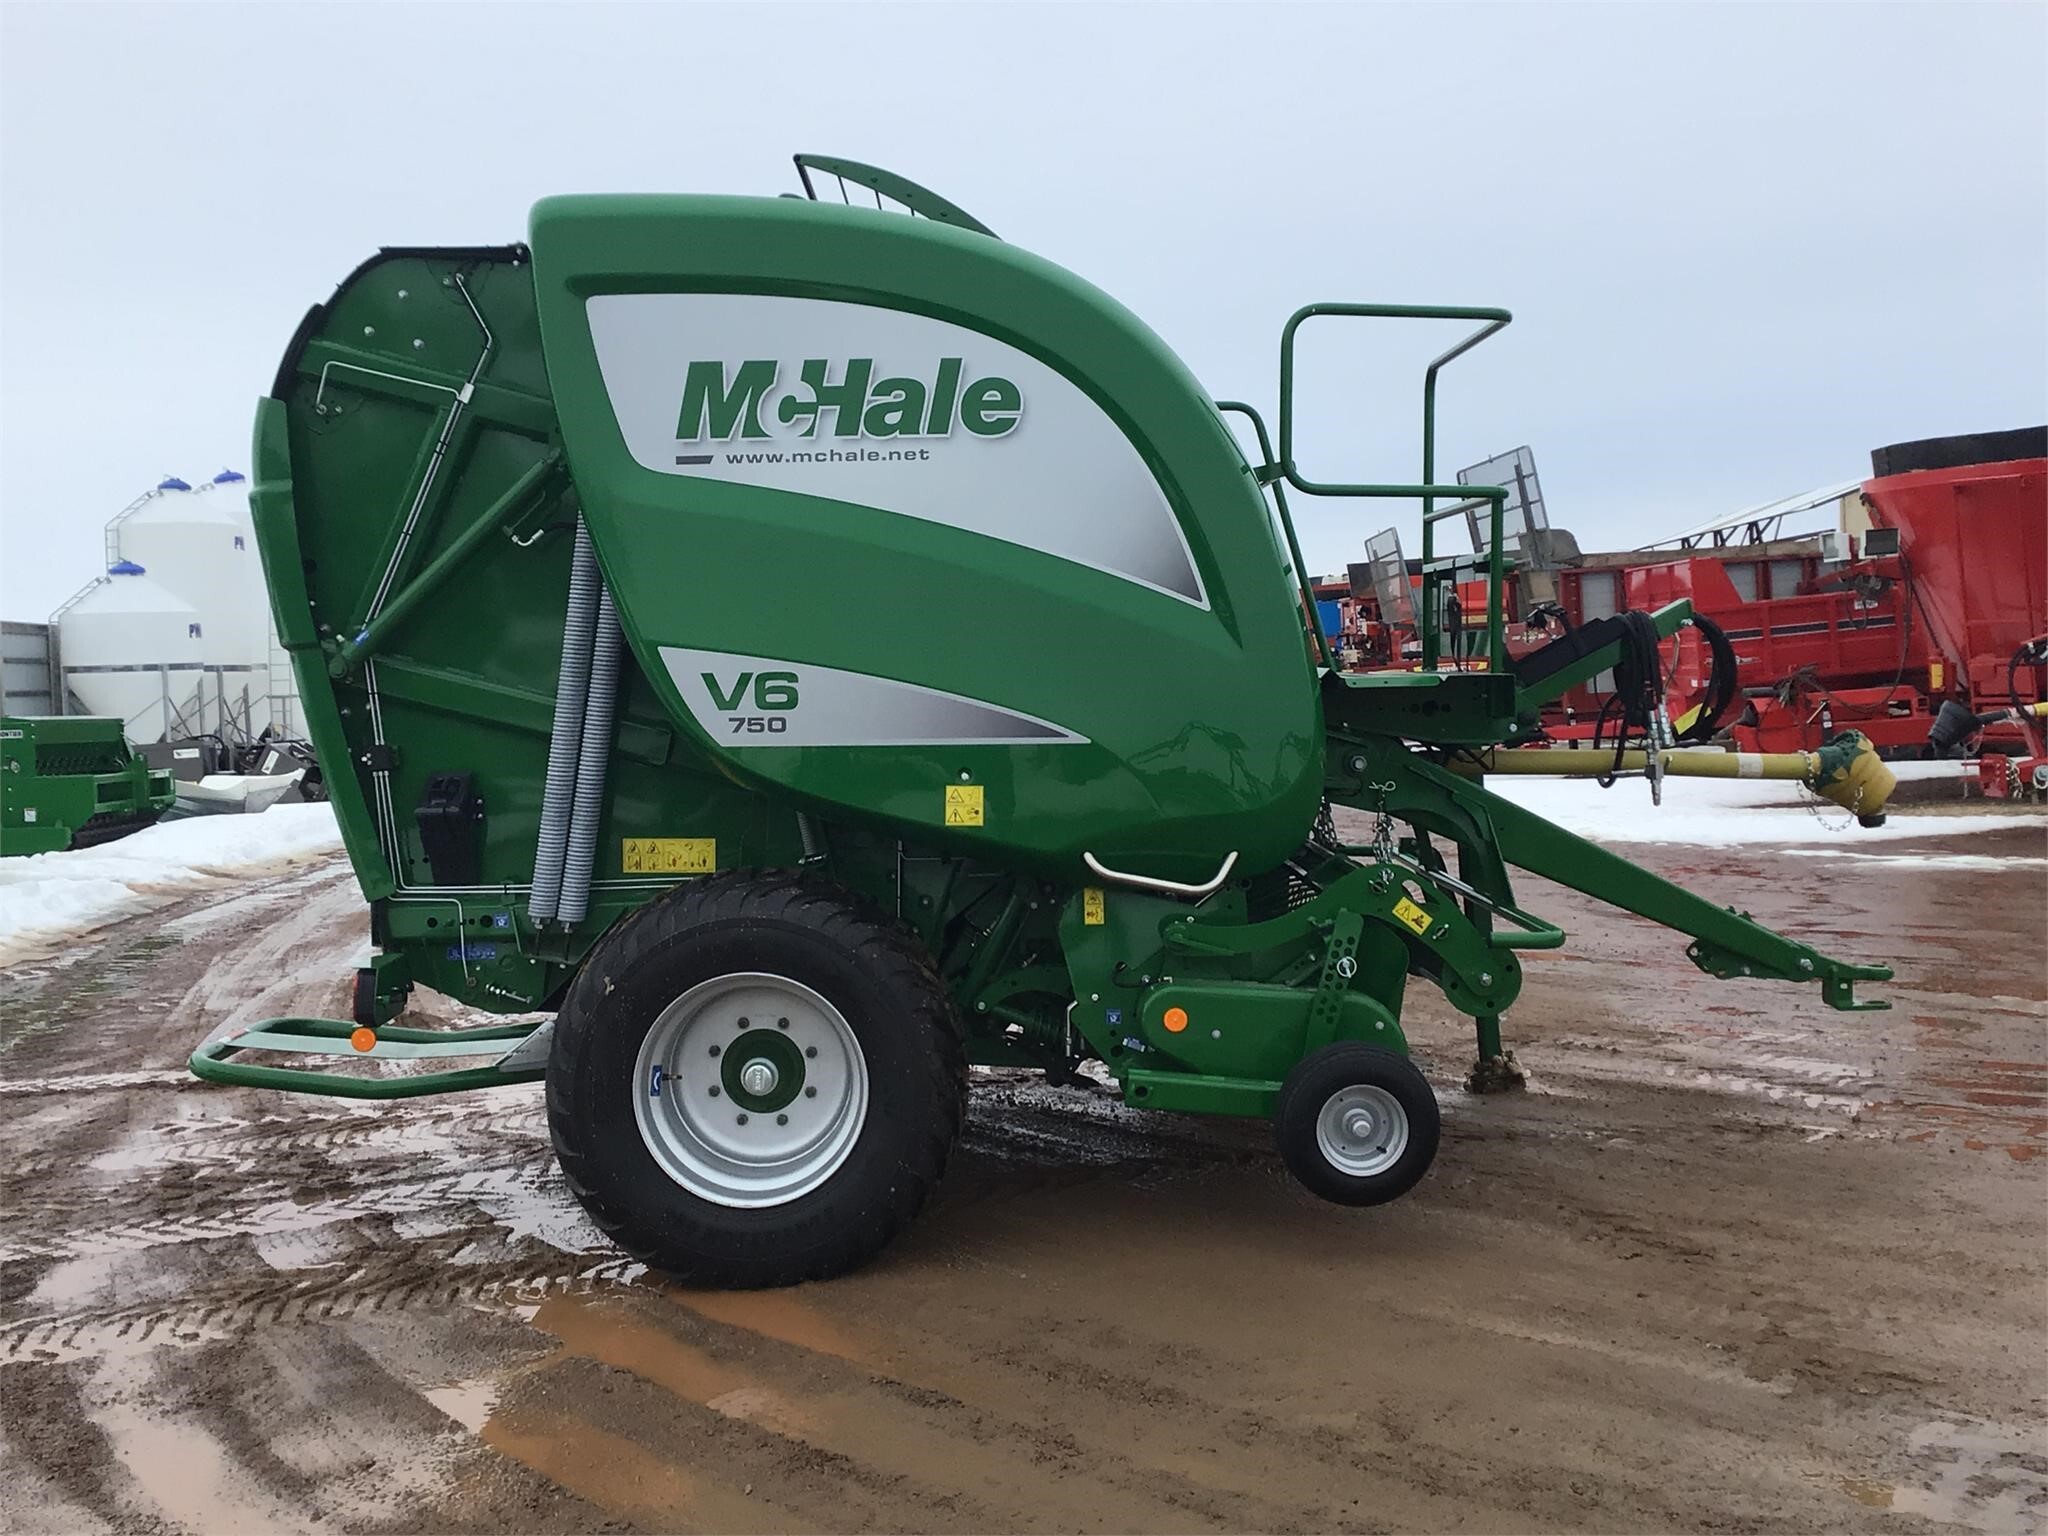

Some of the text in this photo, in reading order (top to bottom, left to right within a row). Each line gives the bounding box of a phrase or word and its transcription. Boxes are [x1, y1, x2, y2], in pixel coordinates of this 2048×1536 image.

[676, 357, 1022, 439] McHale
[725, 448, 930, 465] www.mchale.net
[700, 671, 799, 711] V6
[728, 717, 787, 734] 750
